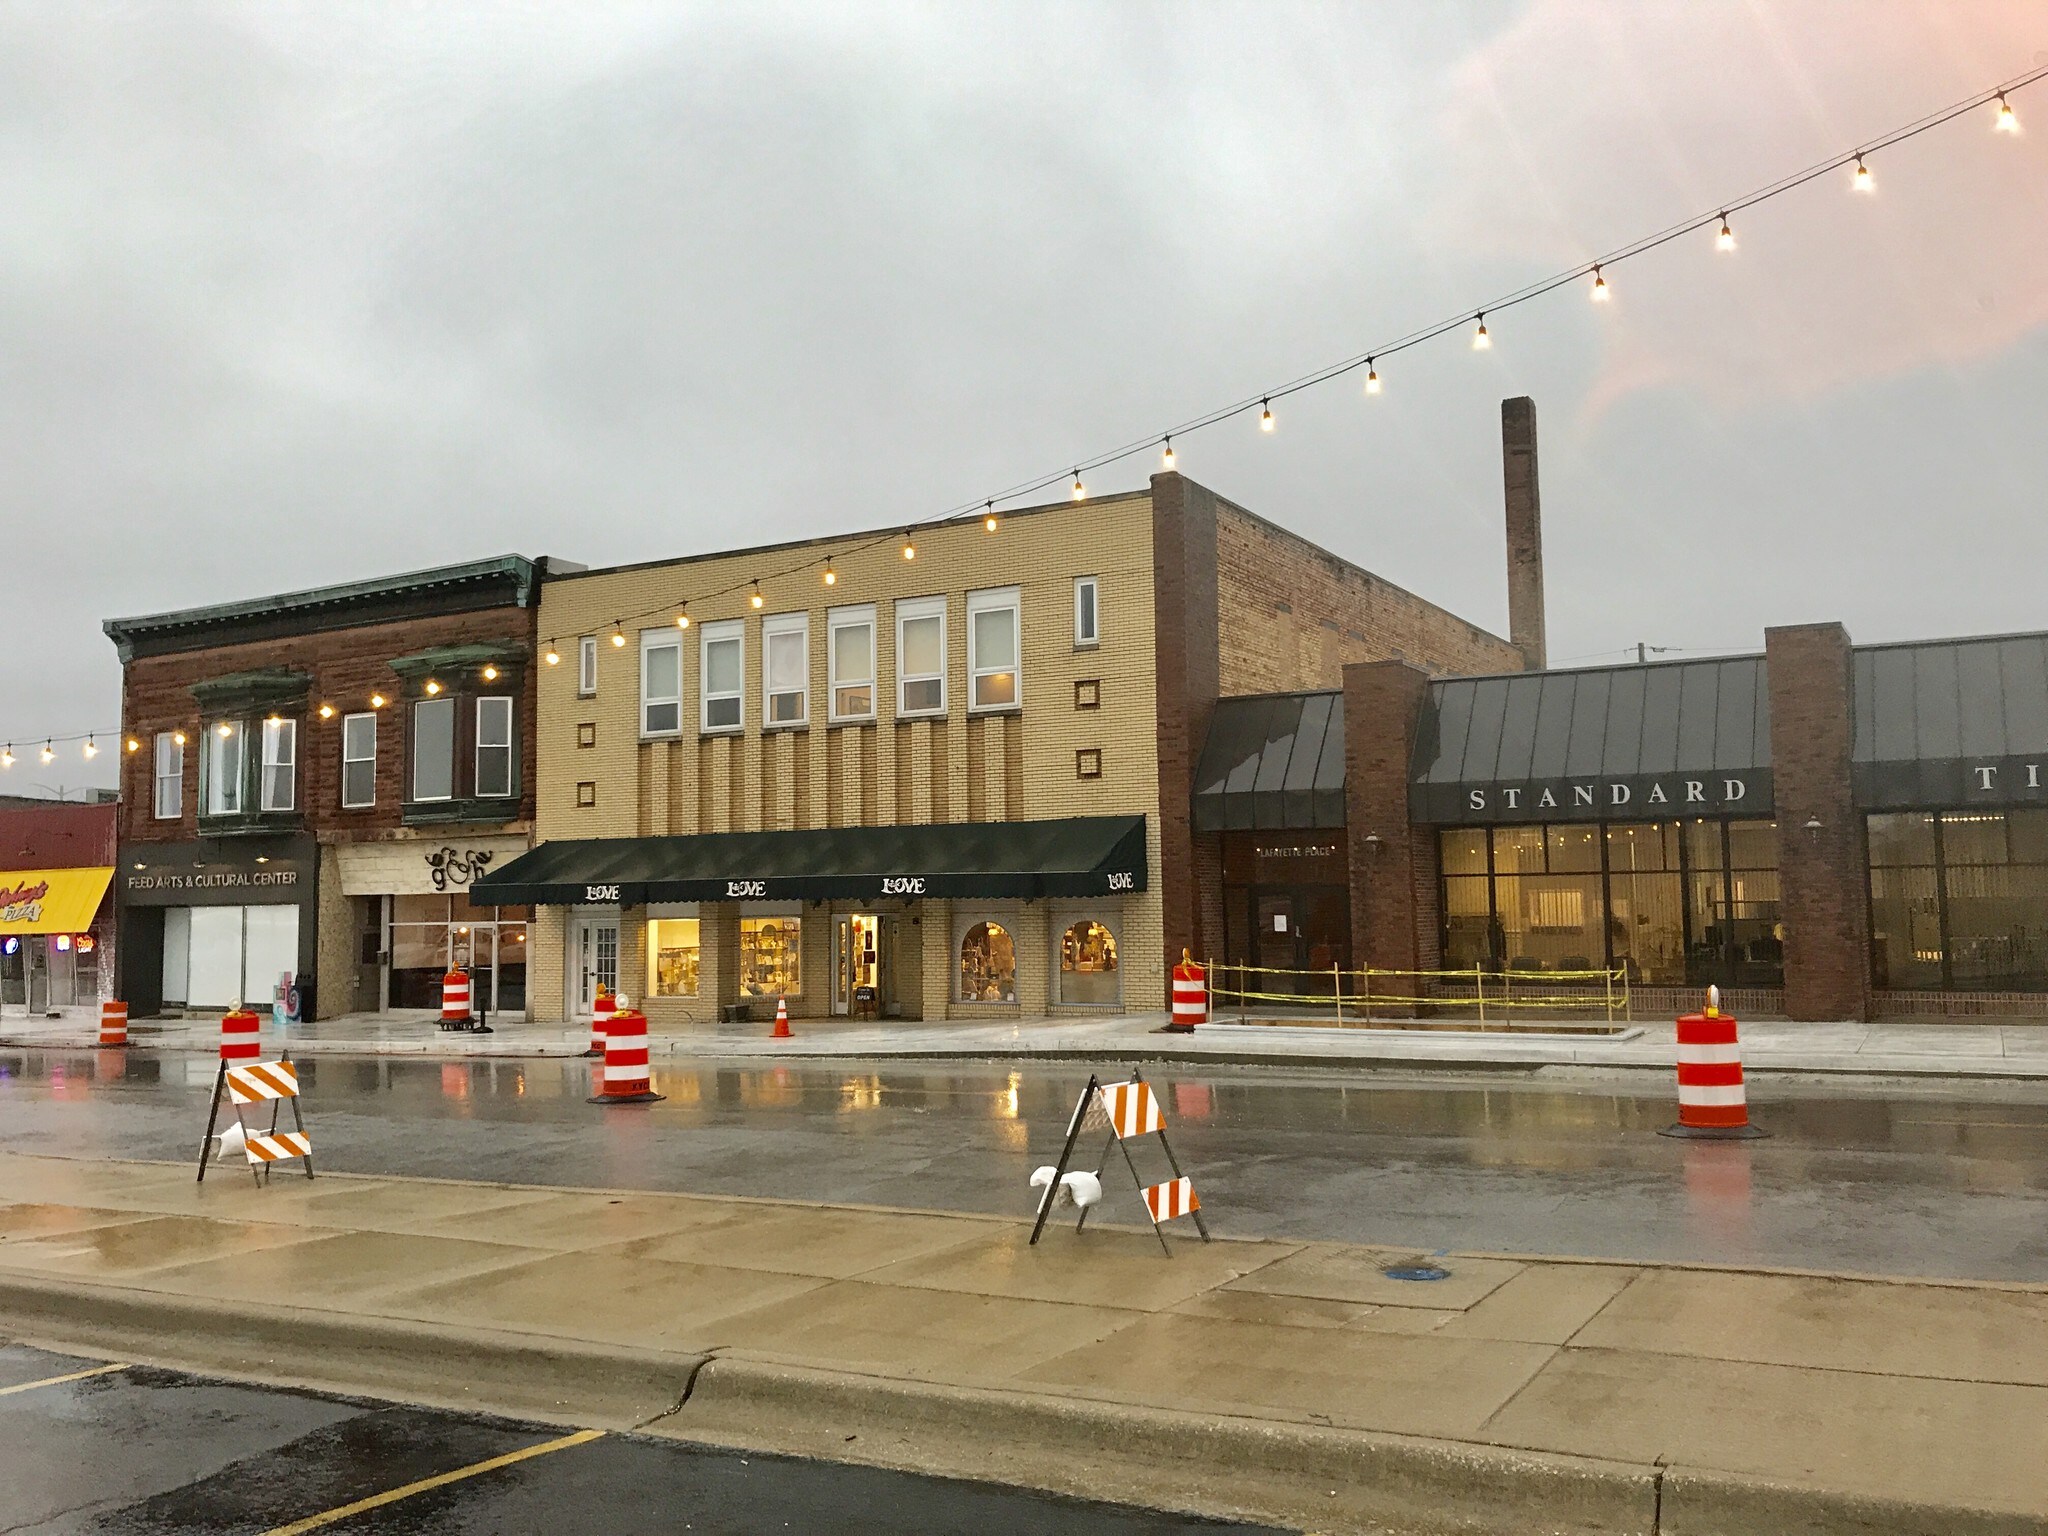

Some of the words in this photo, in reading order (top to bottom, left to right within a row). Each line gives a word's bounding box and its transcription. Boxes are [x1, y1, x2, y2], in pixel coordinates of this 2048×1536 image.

[1470, 779, 1746, 810] STANDARD
[1974, 764, 2041, 790] TI
[128, 877, 154, 889] FEED
[155, 875, 183, 889] ARTS
[185, 875, 193, 888] &
[195, 873, 250, 888] CULTURAL
[252, 871, 297, 886] CENTER
[726, 881, 767, 896] LOVE
[881, 877, 926, 894] LOVE
[1107, 872, 1134, 890] LOVE
[585, 885, 620, 900] LOVE
[4, 905, 36, 921] PIZZA
